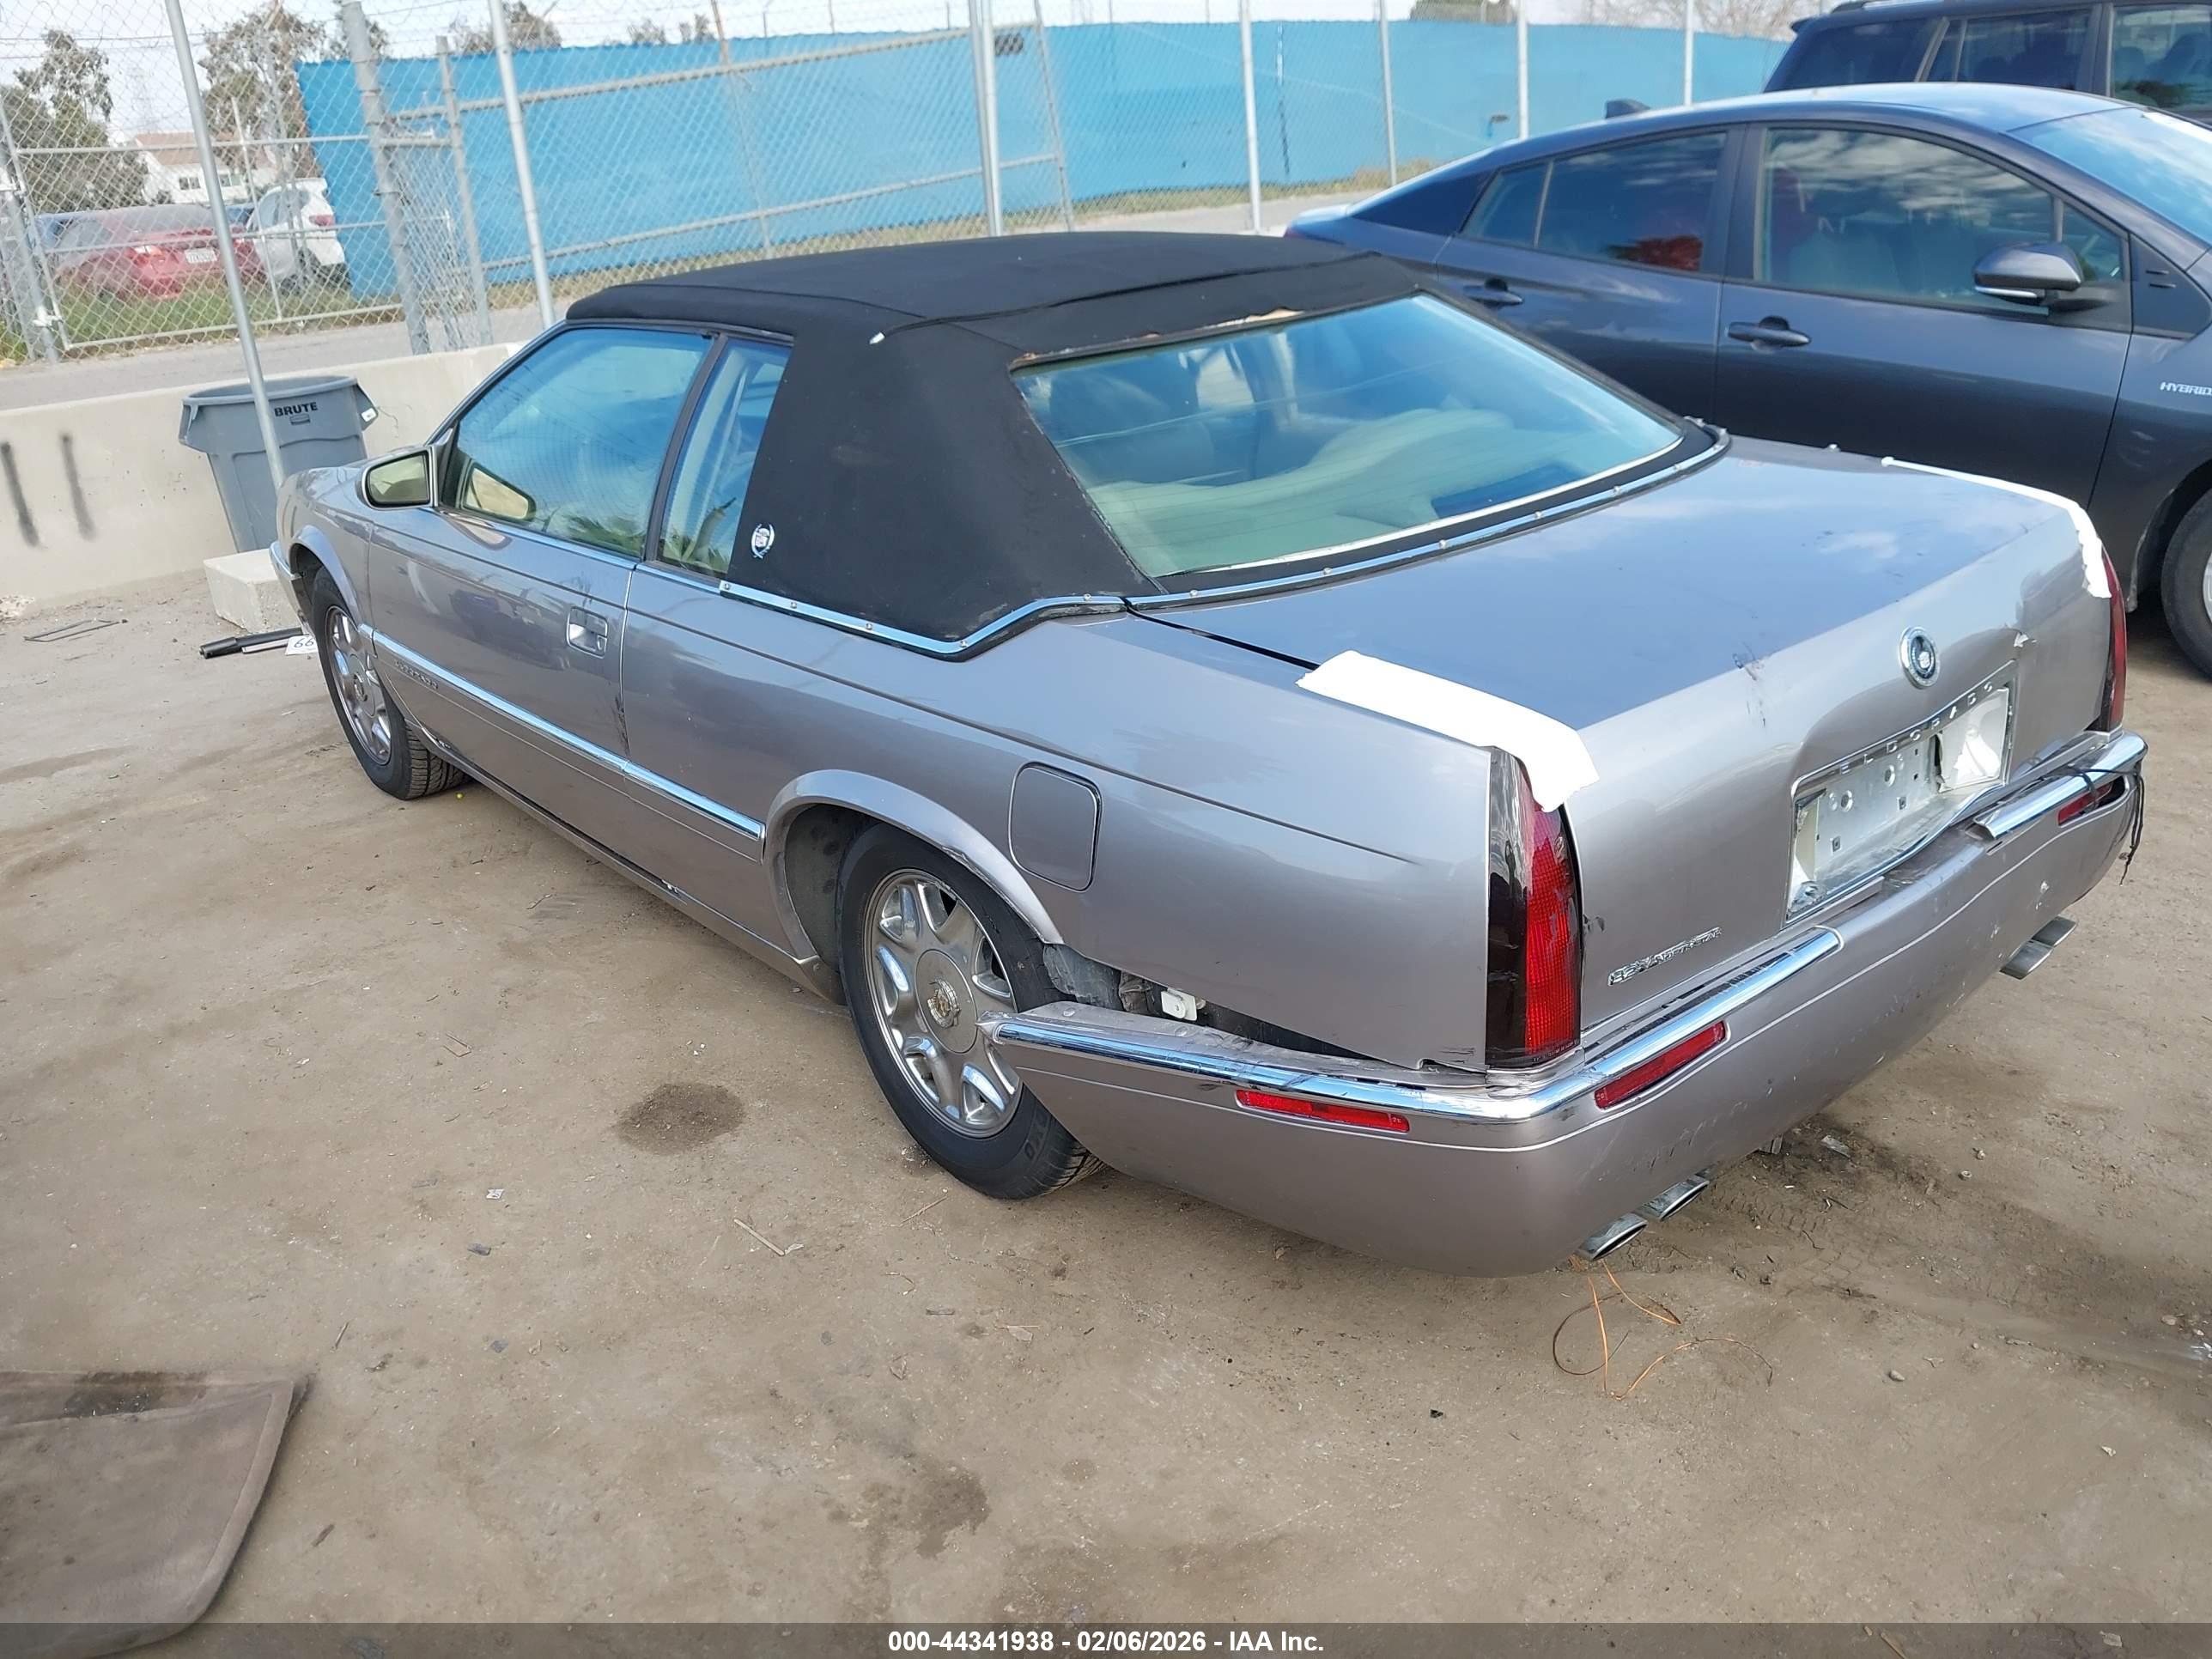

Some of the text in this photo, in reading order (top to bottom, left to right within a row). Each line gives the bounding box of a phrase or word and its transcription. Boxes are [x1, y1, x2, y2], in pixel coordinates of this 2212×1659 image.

[2160, 381, 2212, 396] HYBRID
[274, 401, 318, 417] BRUTE
[1839, 681, 1993, 775] ELDORADO
